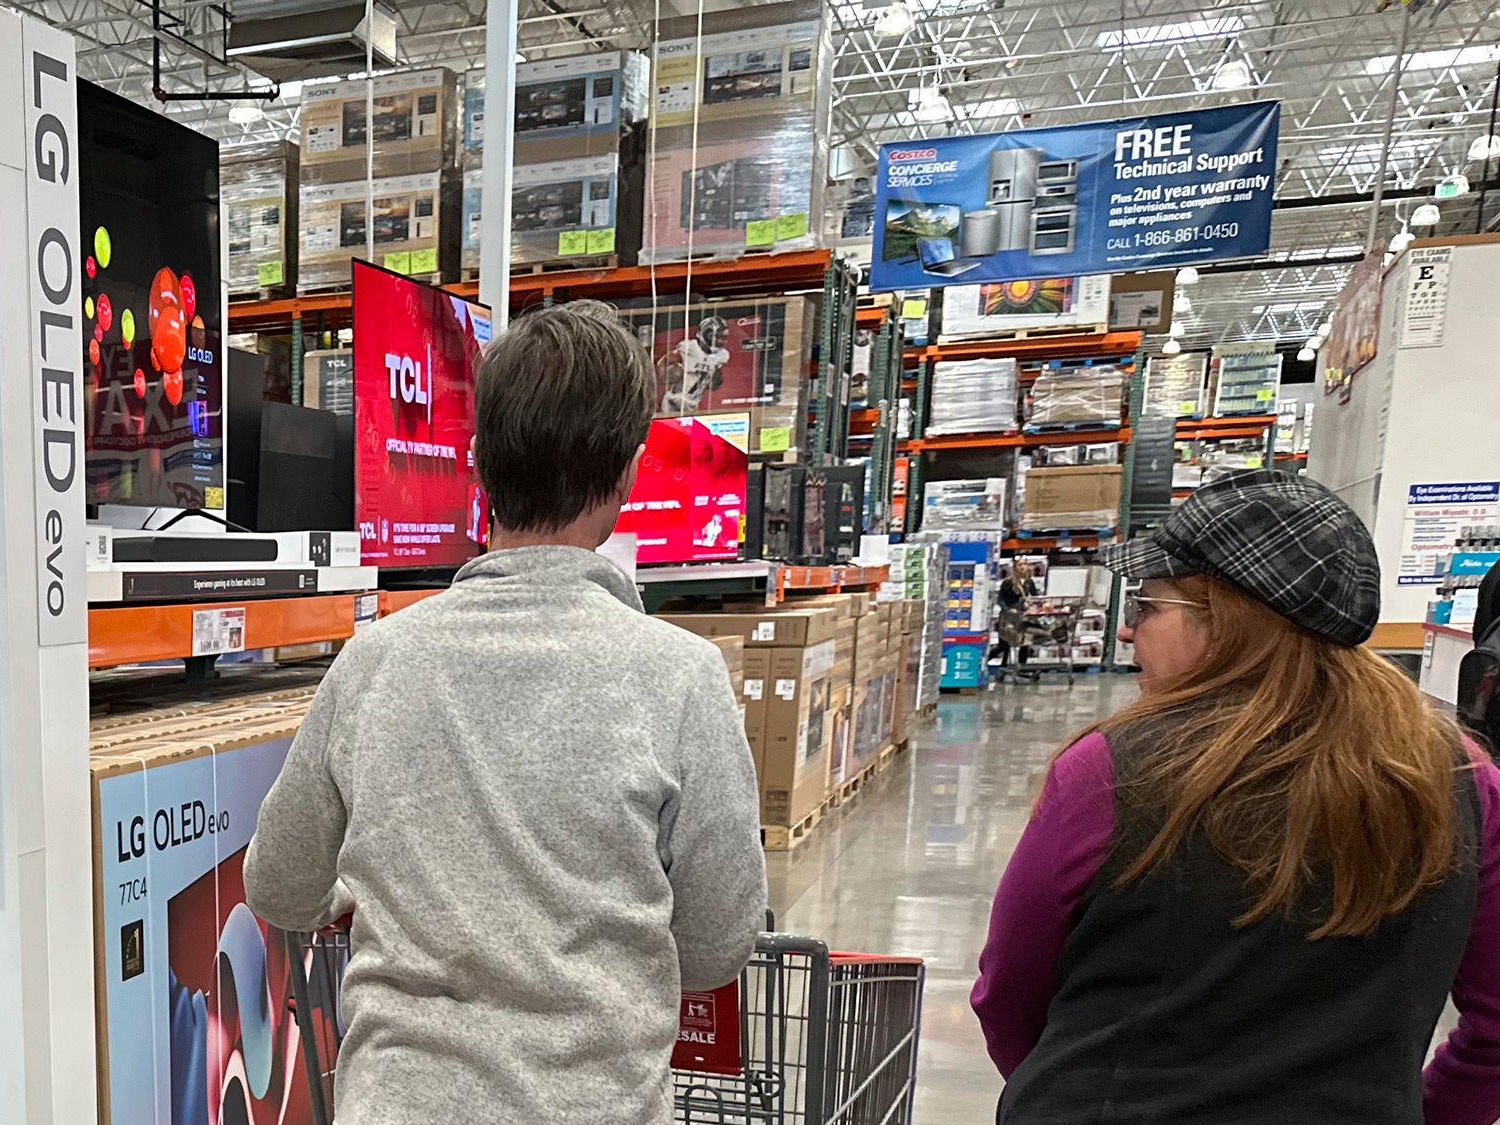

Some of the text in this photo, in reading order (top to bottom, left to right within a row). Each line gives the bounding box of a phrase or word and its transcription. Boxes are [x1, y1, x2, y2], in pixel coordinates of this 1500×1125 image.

[658, 43, 692, 54] SONY
[308, 88, 337, 98] SONY
[1114, 124, 1193, 161] FREE
[889, 149, 936, 160] COSTCO
[888, 161, 958, 176] CONCIERGE
[1113, 147, 1264, 180] Technical Support
[887, 174, 933, 187] SERVICES
[1111, 175, 1270, 204] Plus 2nd year warranty
[1110, 191, 1251, 215] on televisions, computers and
[1109, 211, 1193, 228] major appliances
[1107, 223, 1238, 249] CALL 1-866-861-0450
[1426, 248, 1452, 256] EXAMS
[1419, 265, 1434, 280] E
[1414, 281, 1436, 290] F P
[33, 50, 75, 617] LG OLED evo
[188, 346, 213, 364] LG OLED
[326, 360, 347, 368] TCL
[385, 353, 427, 405] TCL
[1416, 486, 1427, 494] Eye
[359, 522, 376, 539] TCL
[956, 652, 961, 660] 1
[117, 800, 229, 863] LG OLED evo
[119, 877, 148, 906] 77C4
